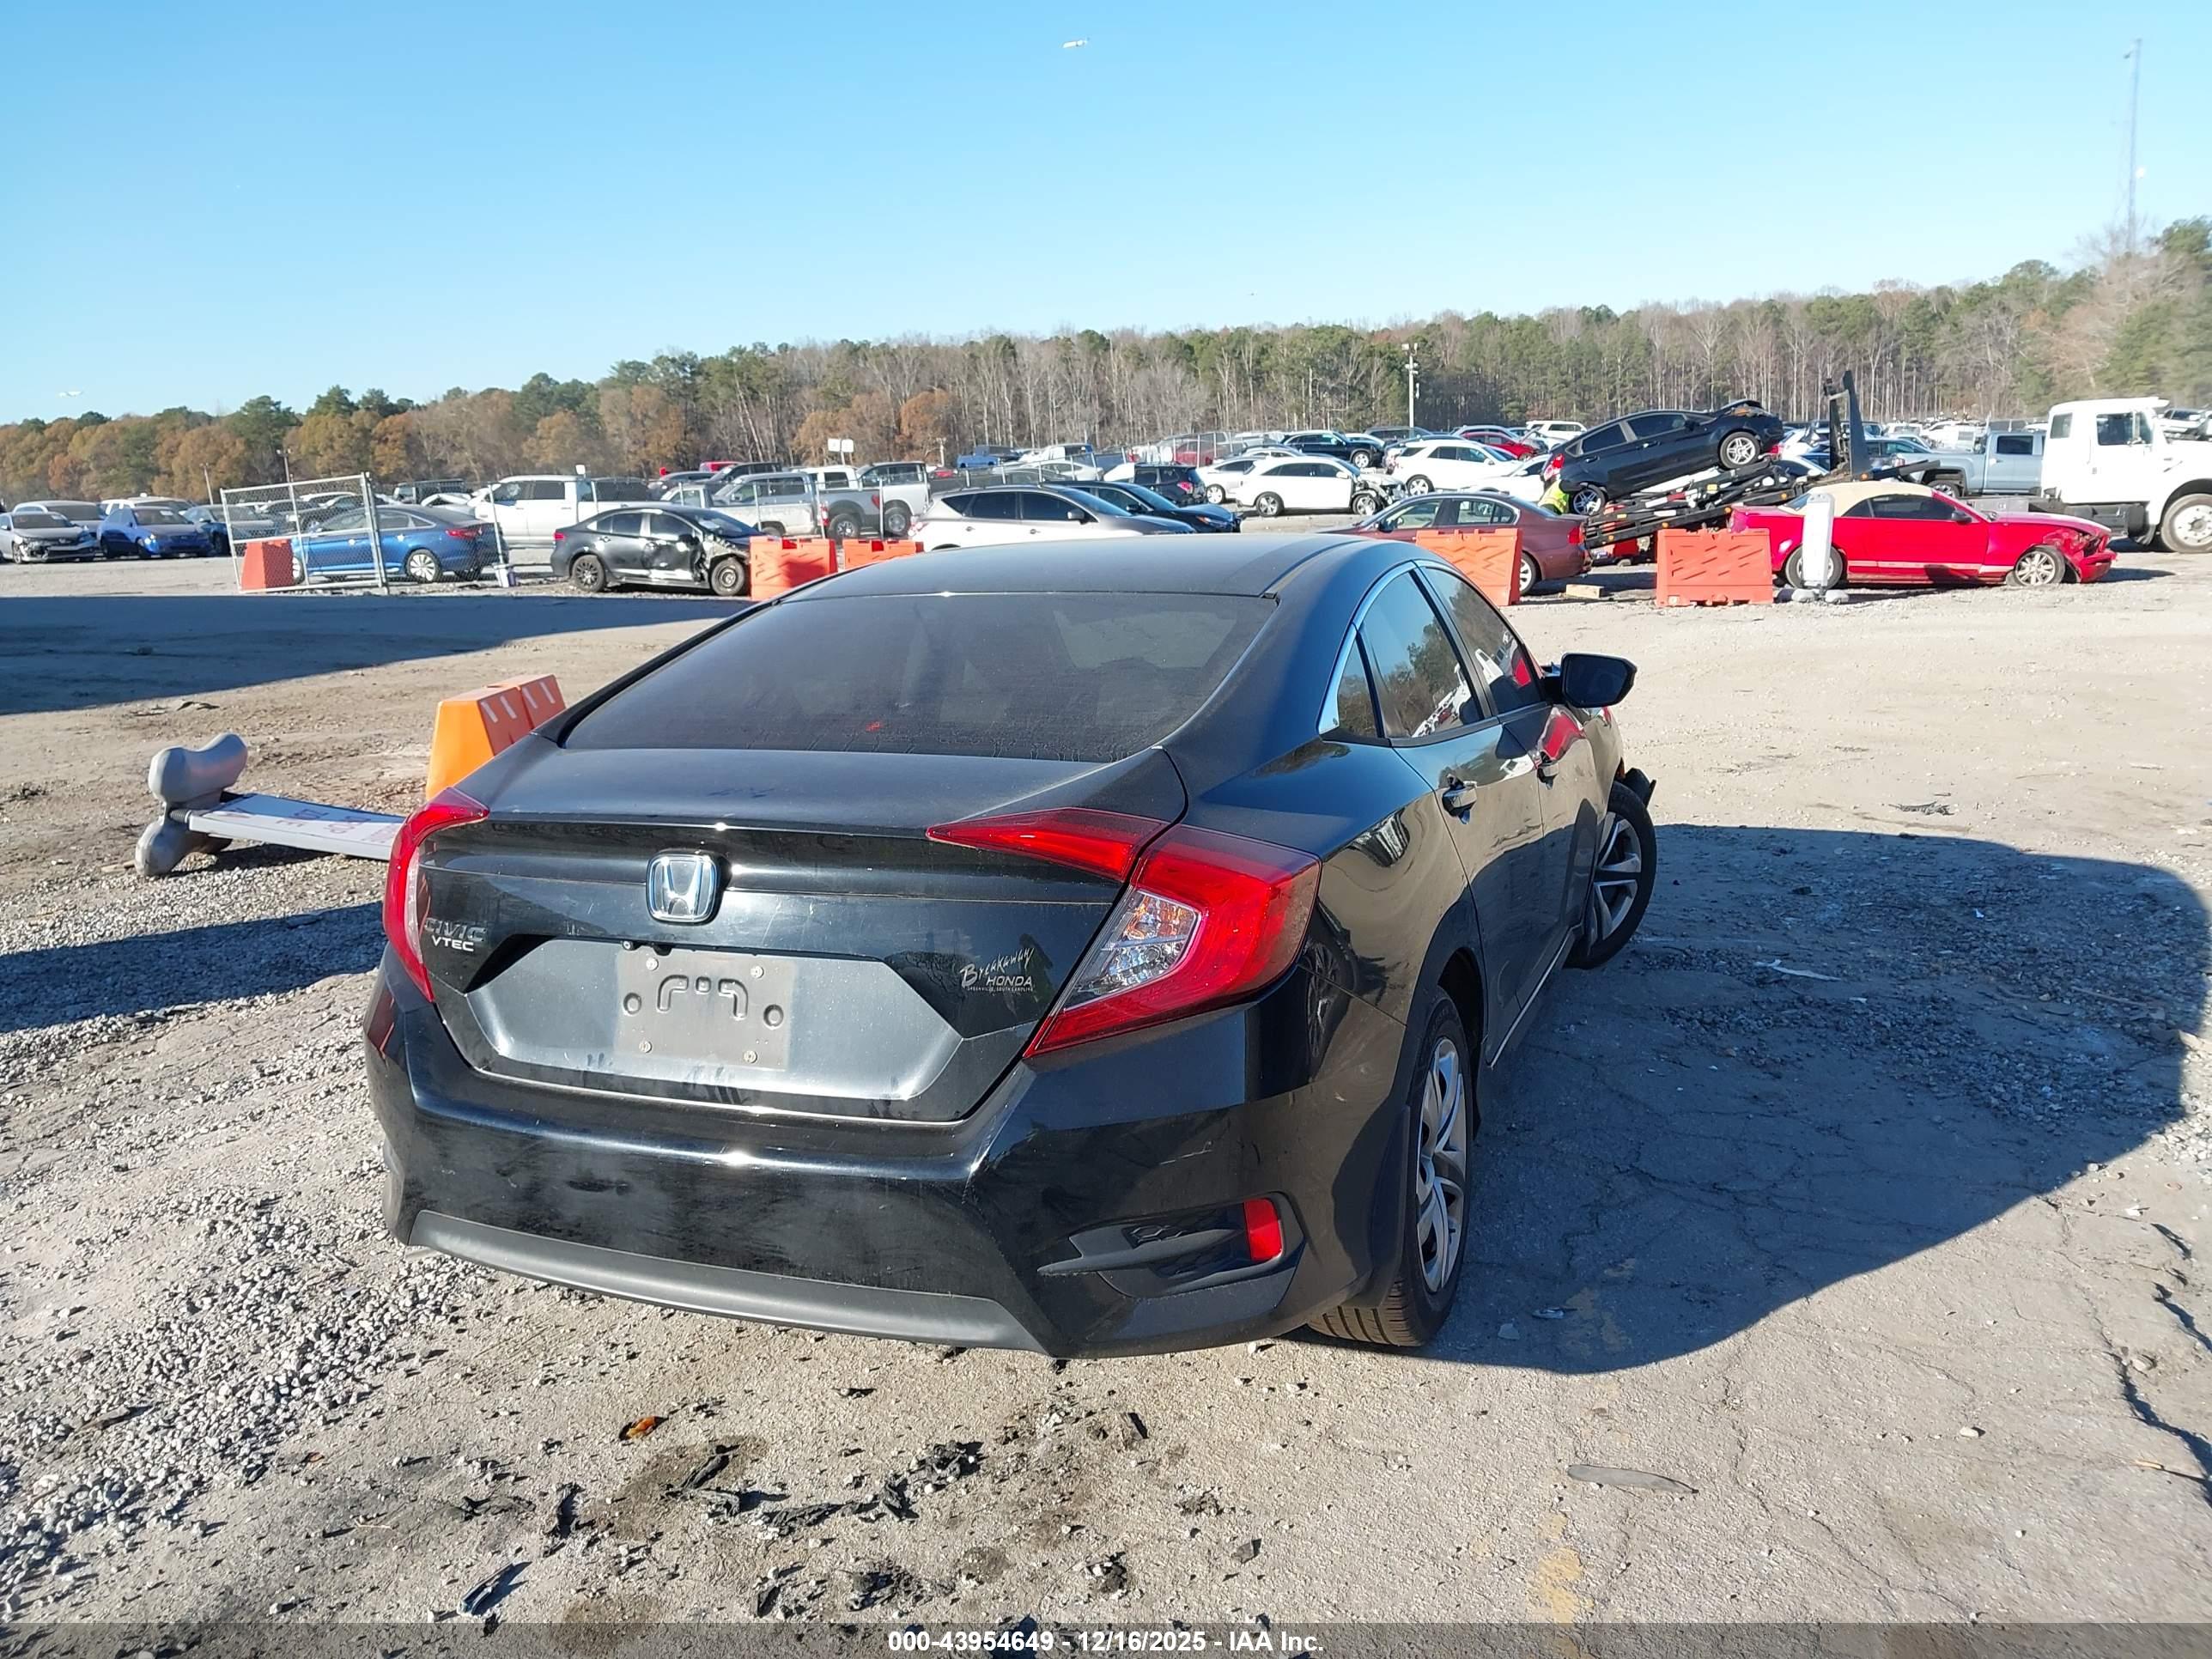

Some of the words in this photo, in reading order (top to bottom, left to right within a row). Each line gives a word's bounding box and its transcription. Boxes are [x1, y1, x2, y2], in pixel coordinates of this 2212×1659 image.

[425, 917, 487, 942] CIVIC
[431, 934, 475, 952] VTEC
[959, 947, 1035, 988] Breakaway
[986, 975, 1033, 987] HONDA
